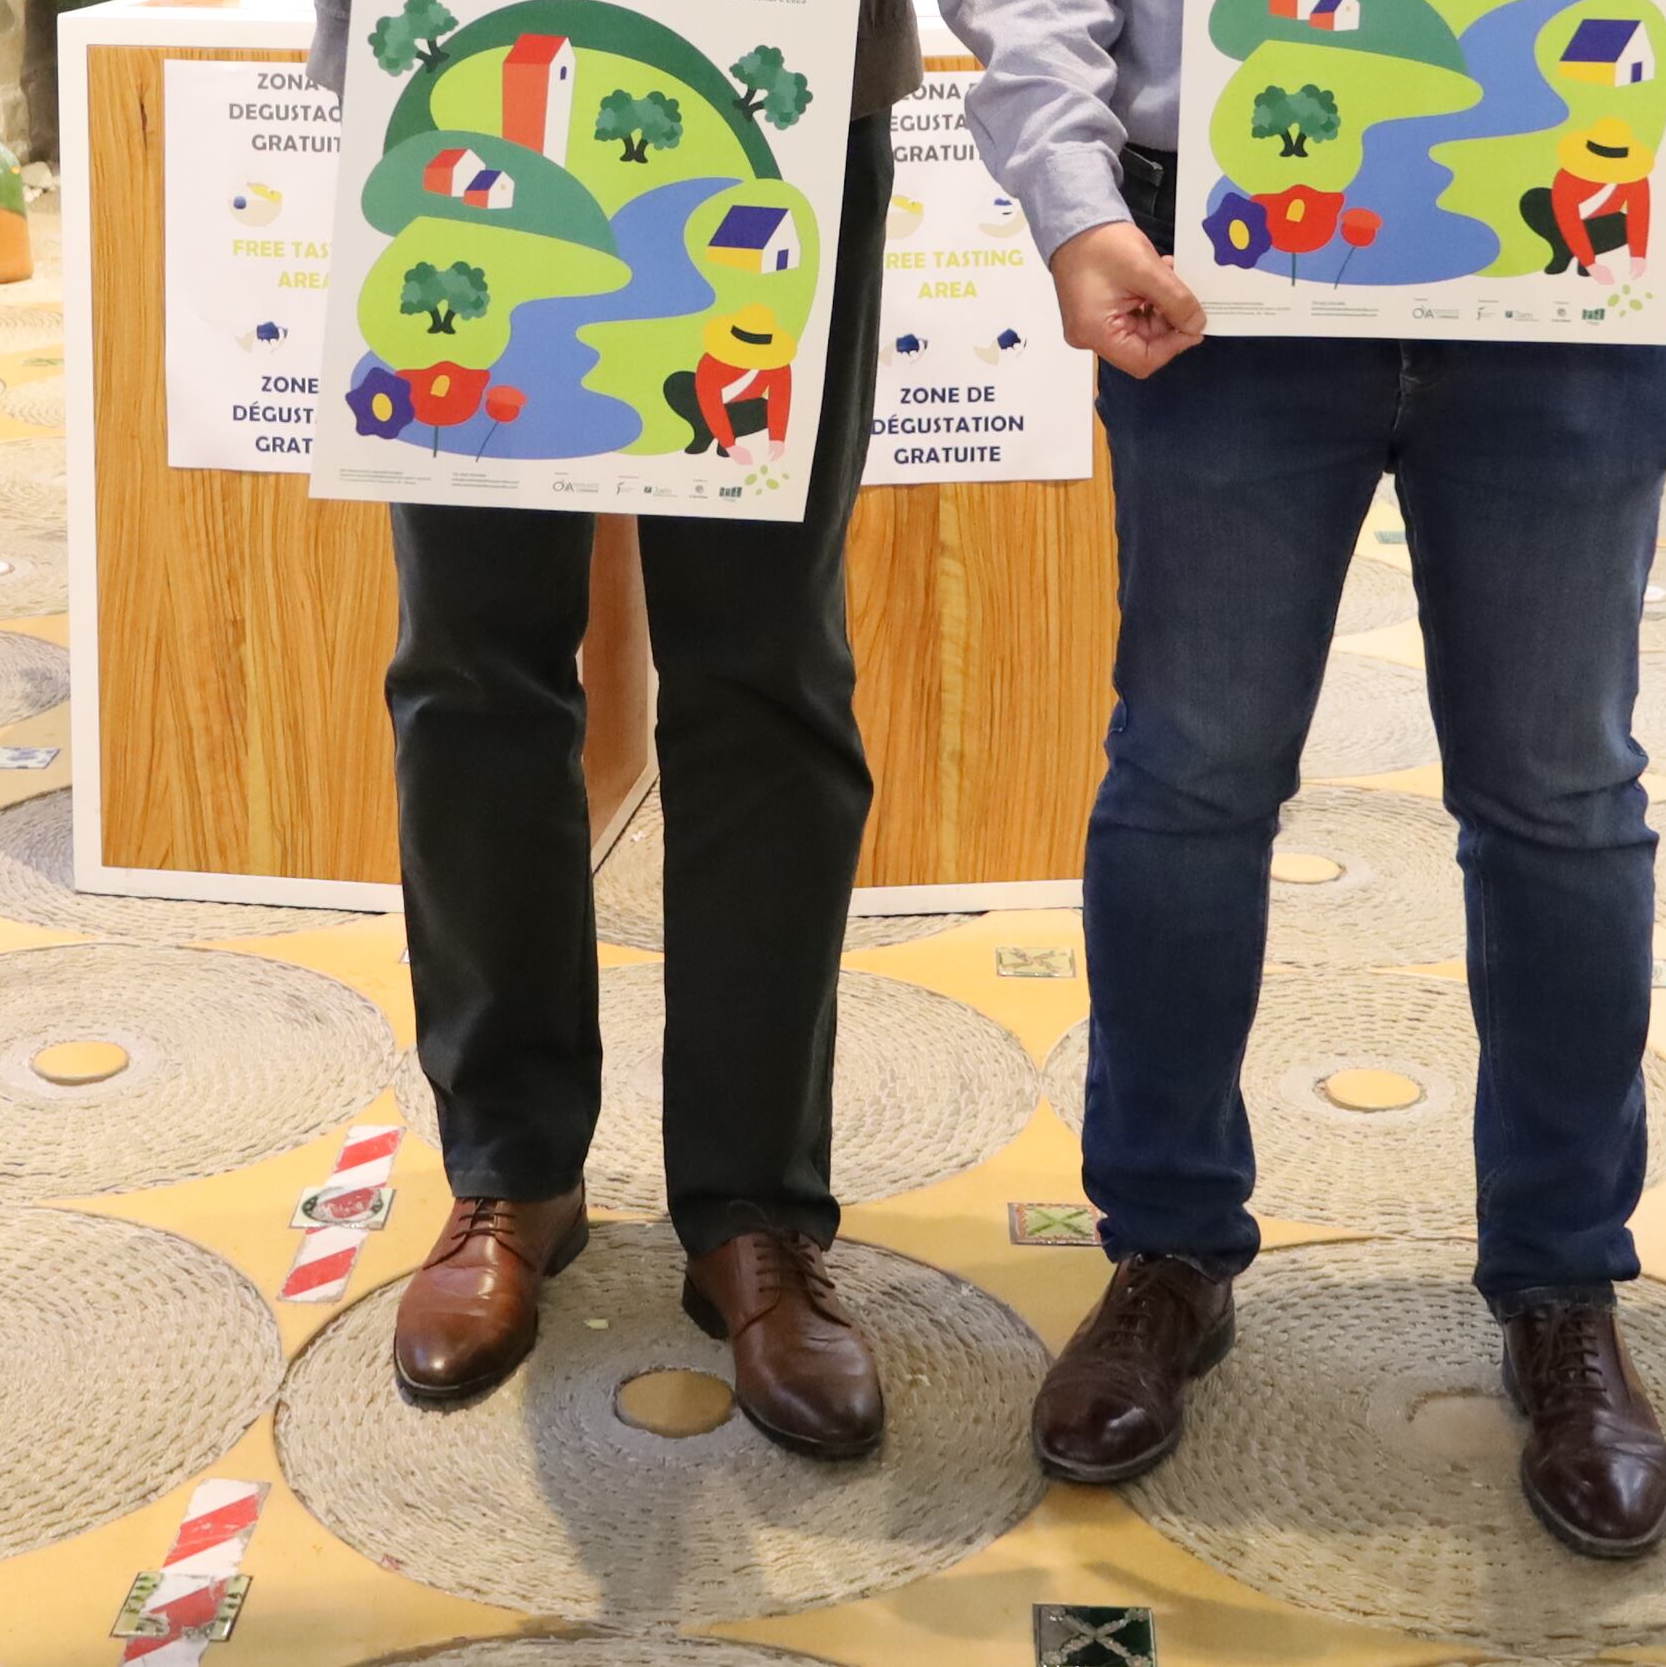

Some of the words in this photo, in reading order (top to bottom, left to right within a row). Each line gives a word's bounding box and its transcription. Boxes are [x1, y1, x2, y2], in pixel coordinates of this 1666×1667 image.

[257, 72, 319, 91] ZONA
[901, 83, 961, 101] ONA
[228, 102, 342, 122] DEGUSTAC
[890, 113, 967, 131] EGUSTA
[251, 133, 341, 153] GRATUIT
[894, 144, 981, 163] GRATUI
[232, 239, 285, 258] FREE
[292, 241, 329, 260] TAS
[886, 251, 926, 269] REE
[933, 249, 1024, 268] TASTING
[918, 281, 978, 299] AREA
[261, 376, 319, 394] ZONE
[900, 387, 959, 404] ZONE
[967, 386, 995, 403] DE
[232, 402, 317, 424] DÉGUST
[872, 414, 1024, 435] DÉGUSTATION
[255, 436, 313, 455] GRAT
[893, 446, 1001, 465] GRATUITE
